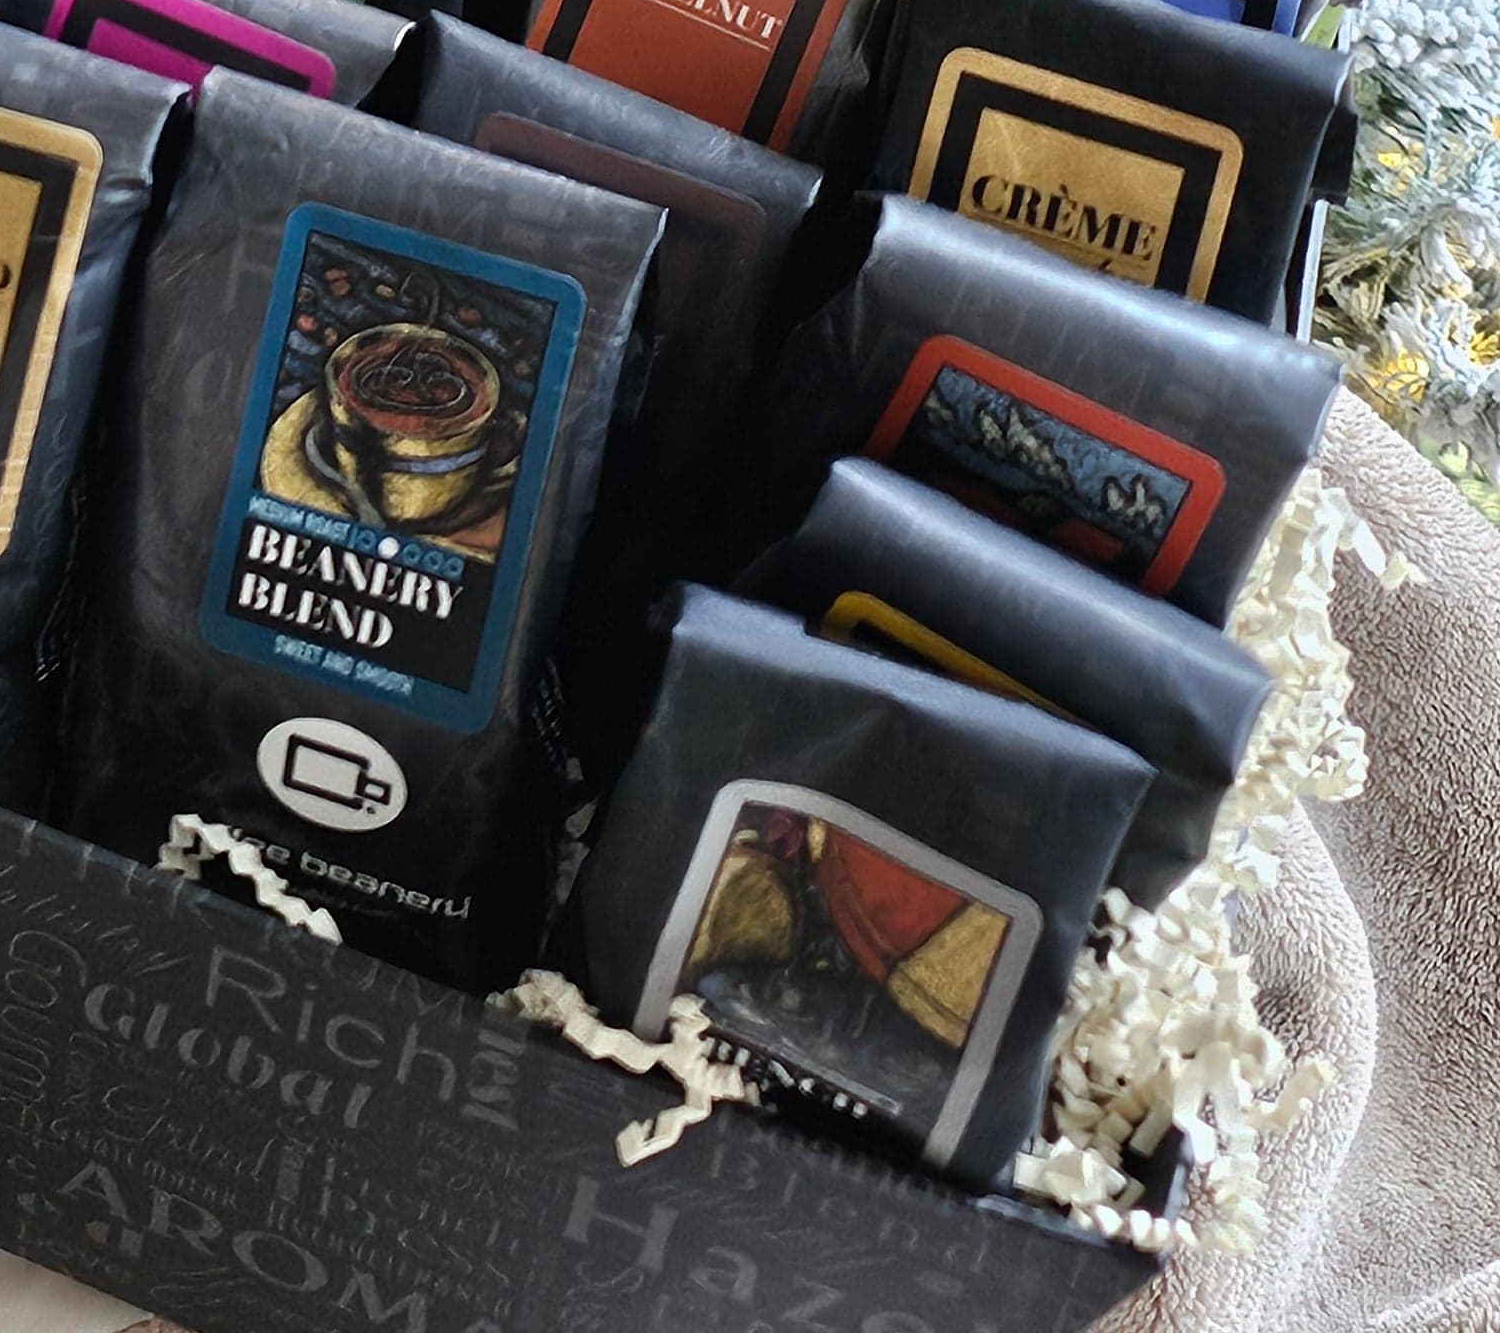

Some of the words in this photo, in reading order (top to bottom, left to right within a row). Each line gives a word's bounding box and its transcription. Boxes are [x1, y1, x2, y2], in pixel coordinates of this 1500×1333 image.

[971, 173, 1158, 262] CRÈME
[238, 572, 395, 649] BLEND
[247, 524, 465, 621] BEANERY
[300, 851, 473, 921] beanery
[83, 983, 373, 1129] Global
[203, 944, 457, 1102] Rich
[56, 1160, 498, 1333] AROM
